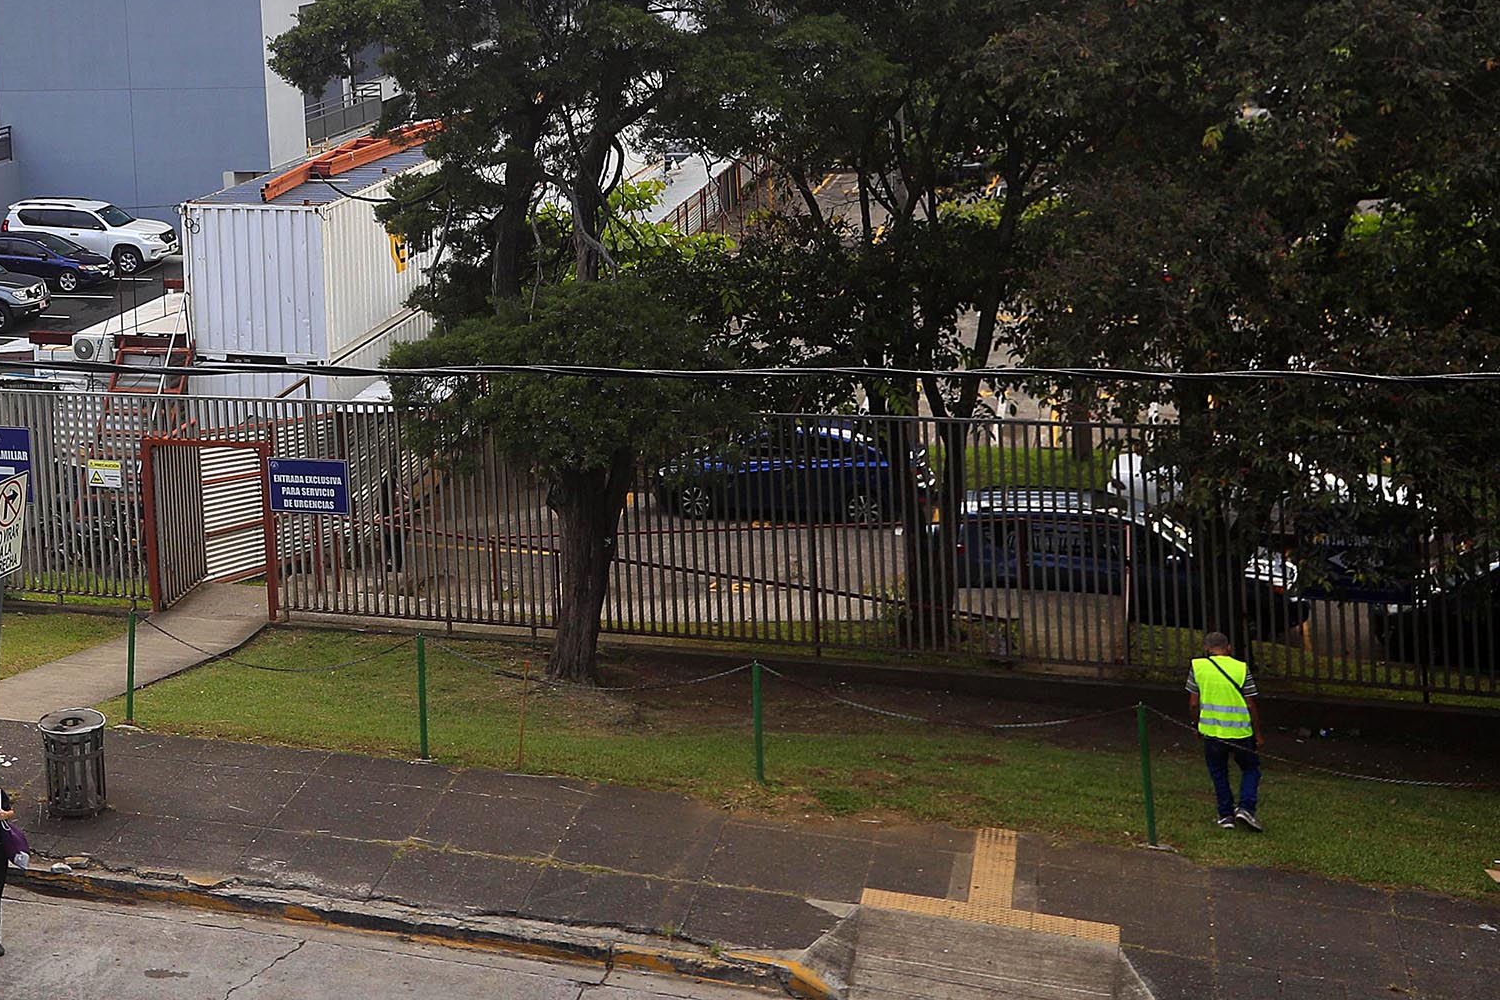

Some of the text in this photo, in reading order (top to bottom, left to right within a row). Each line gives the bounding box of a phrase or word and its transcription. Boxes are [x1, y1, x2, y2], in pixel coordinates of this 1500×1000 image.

[273, 474, 342, 485] ENTRADA EXCLUSIVA
[281, 486, 335, 497] PARA SERVICIO
[283, 498, 335, 510] DE URGENCIAS
[3, 523, 20, 542] VIRAR
[0, 542, 12, 558] A LA
